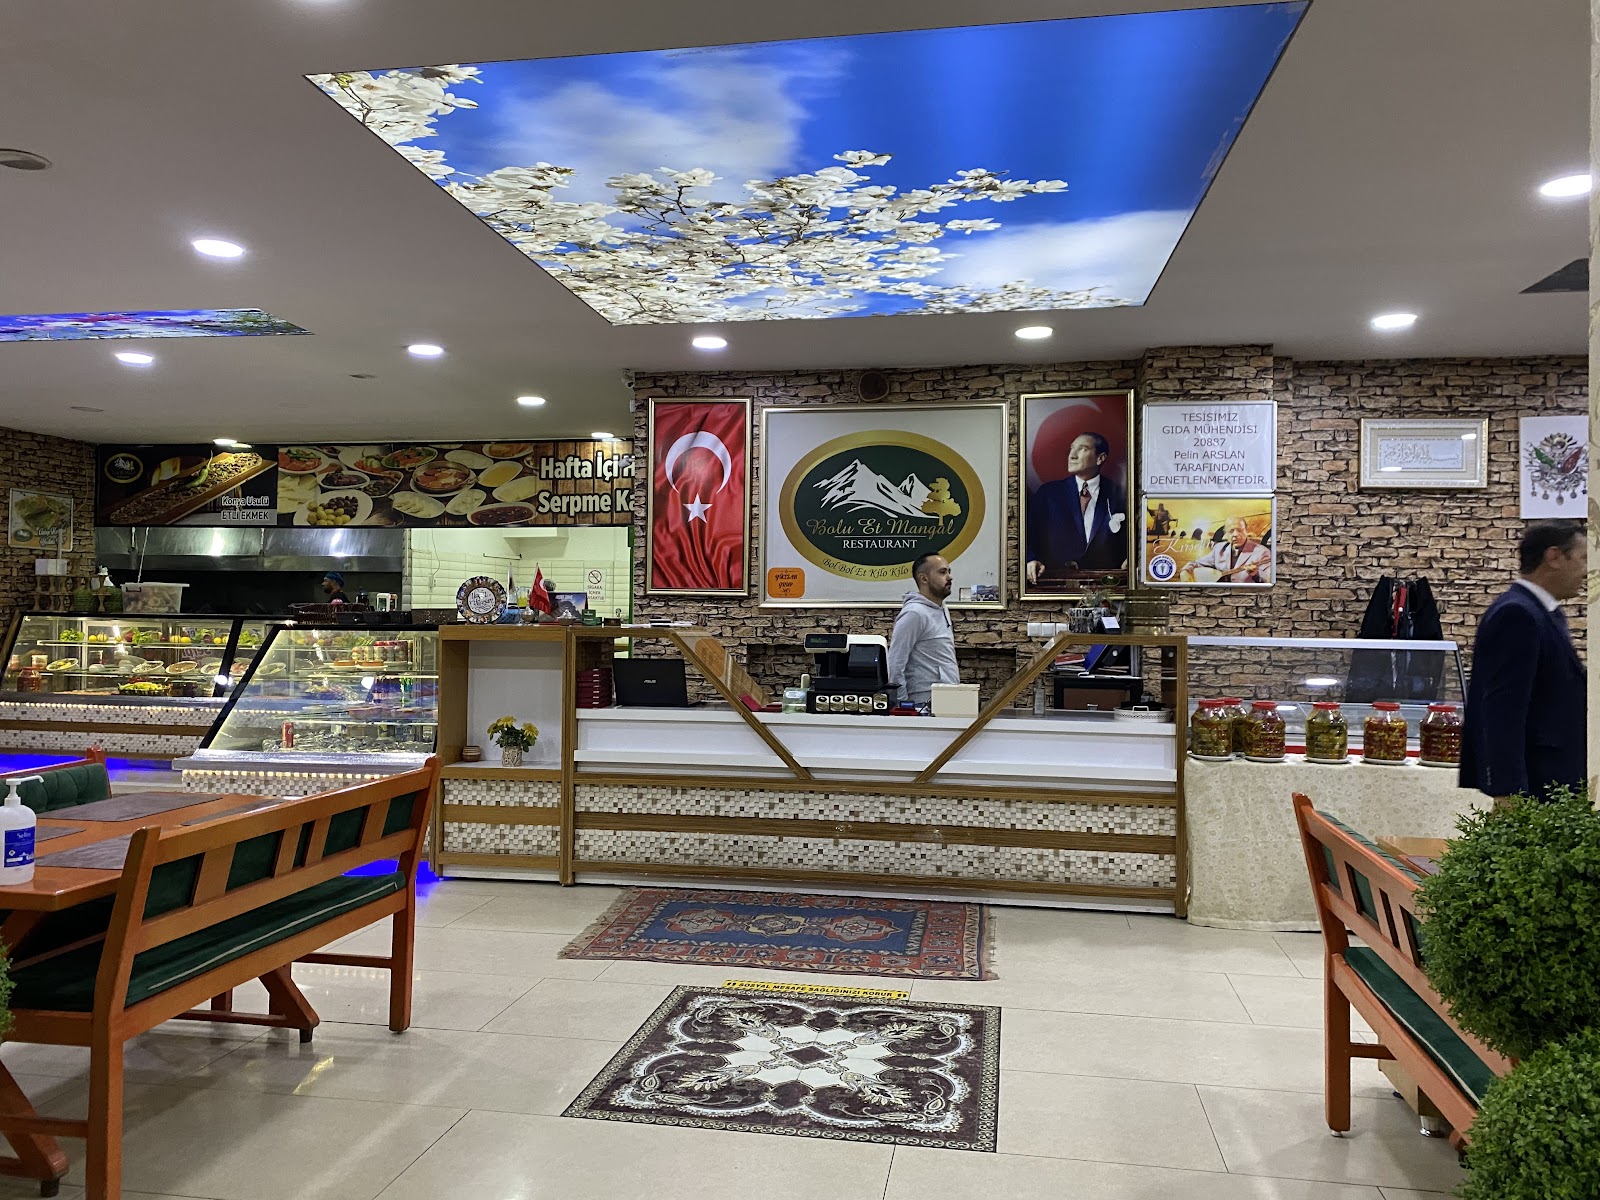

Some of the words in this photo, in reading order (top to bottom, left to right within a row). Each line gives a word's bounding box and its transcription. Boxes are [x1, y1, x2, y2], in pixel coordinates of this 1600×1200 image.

[1162, 425, 1191, 435] GIDA
[1174, 450, 1199, 460] Pelin
[1202, 450, 1245, 460] ARSLAN
[540, 455, 593, 479] Hafta
[1174, 462, 1245, 472] TARAFINDAN
[222, 496, 246, 508] Konya
[538, 491, 612, 517] Serpme
[241, 510, 269, 520] EKMEK
[806, 518, 855, 536] Bolu
[858, 518, 883, 535] Et
[886, 518, 956, 540] Mangal
[842, 539, 918, 549] RESTAURANT
[823, 557, 838, 570] Bol
[839, 563, 857, 575] Bol
[855, 568, 867, 577] Et
